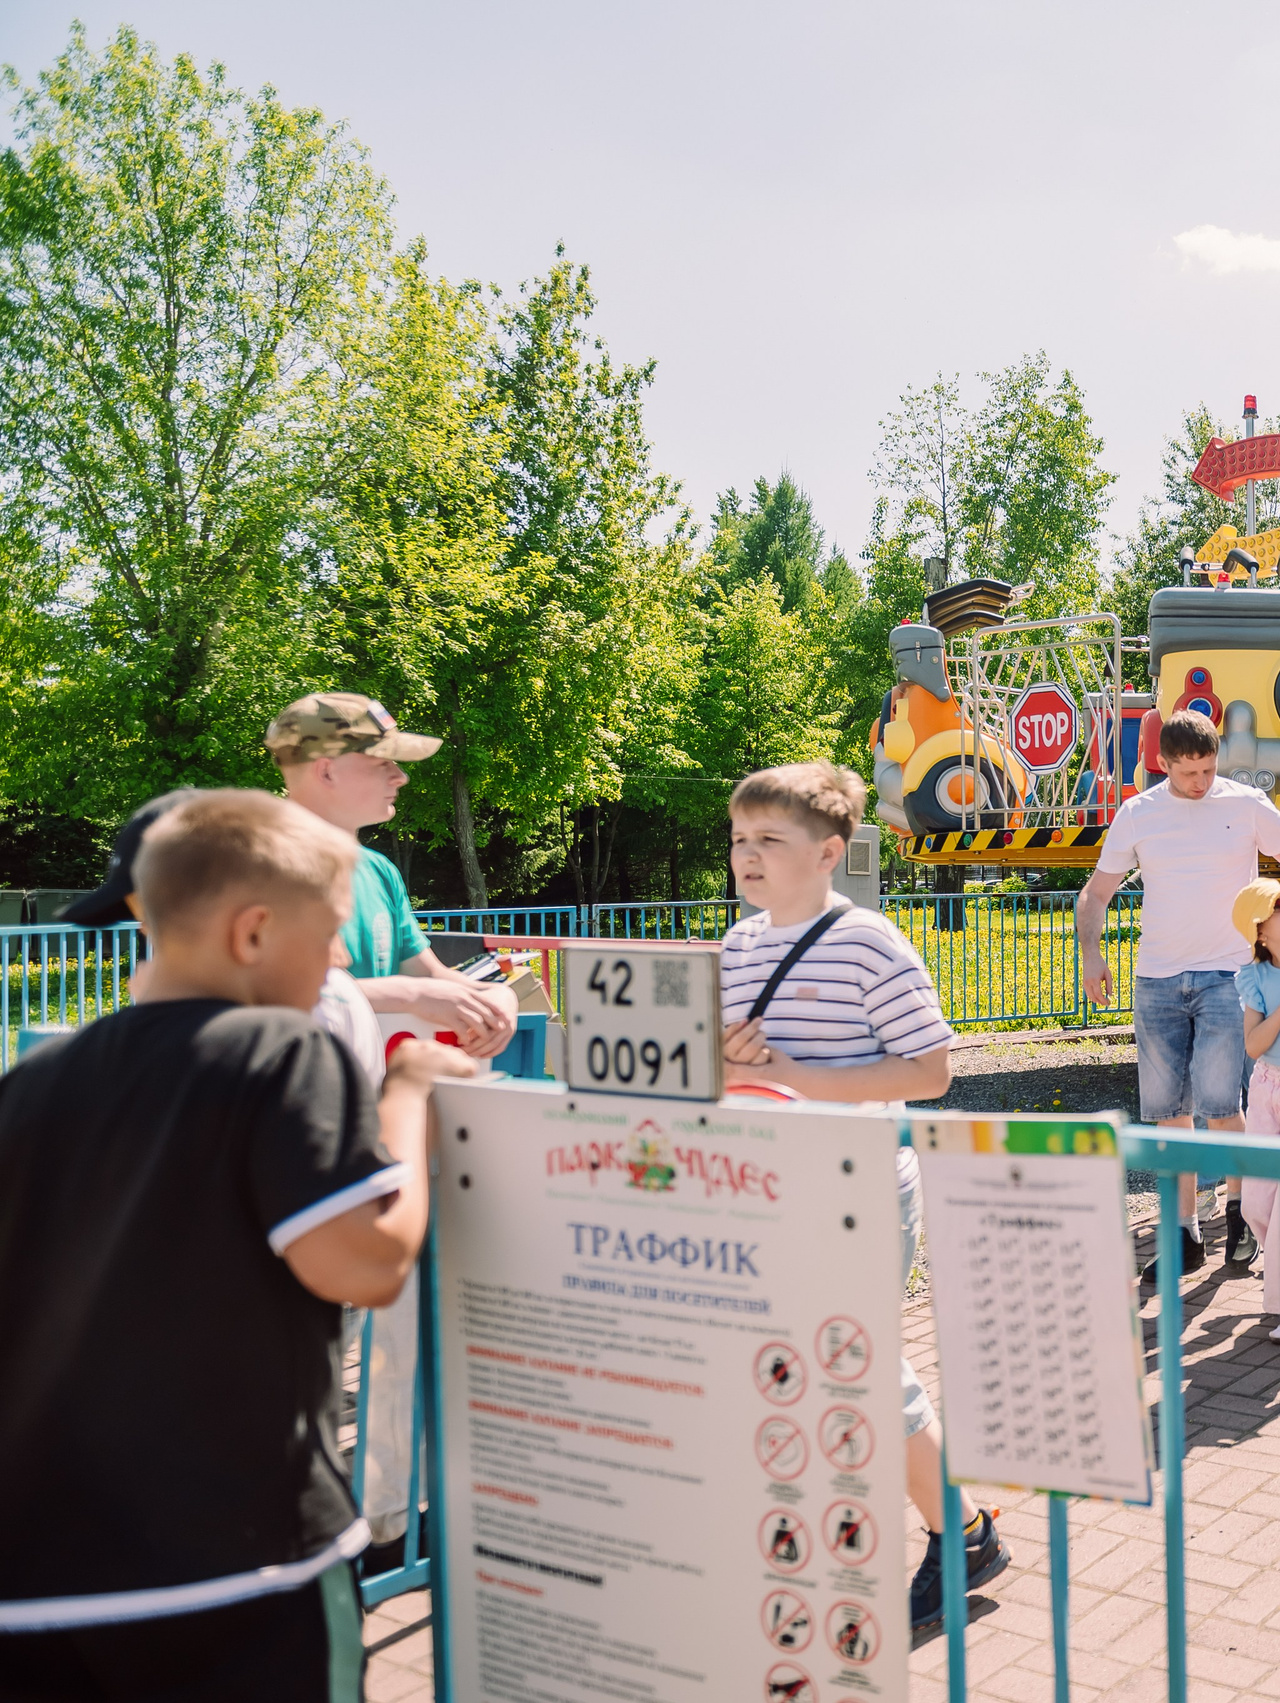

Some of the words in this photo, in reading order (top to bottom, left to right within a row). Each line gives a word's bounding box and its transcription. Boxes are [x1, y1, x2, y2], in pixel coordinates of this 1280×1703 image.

[1018, 711, 1069, 750] STOP
[587, 959, 634, 1007] 42
[587, 1036, 690, 1089] 0091
[566, 1222, 761, 1278] ТРАФФИК
